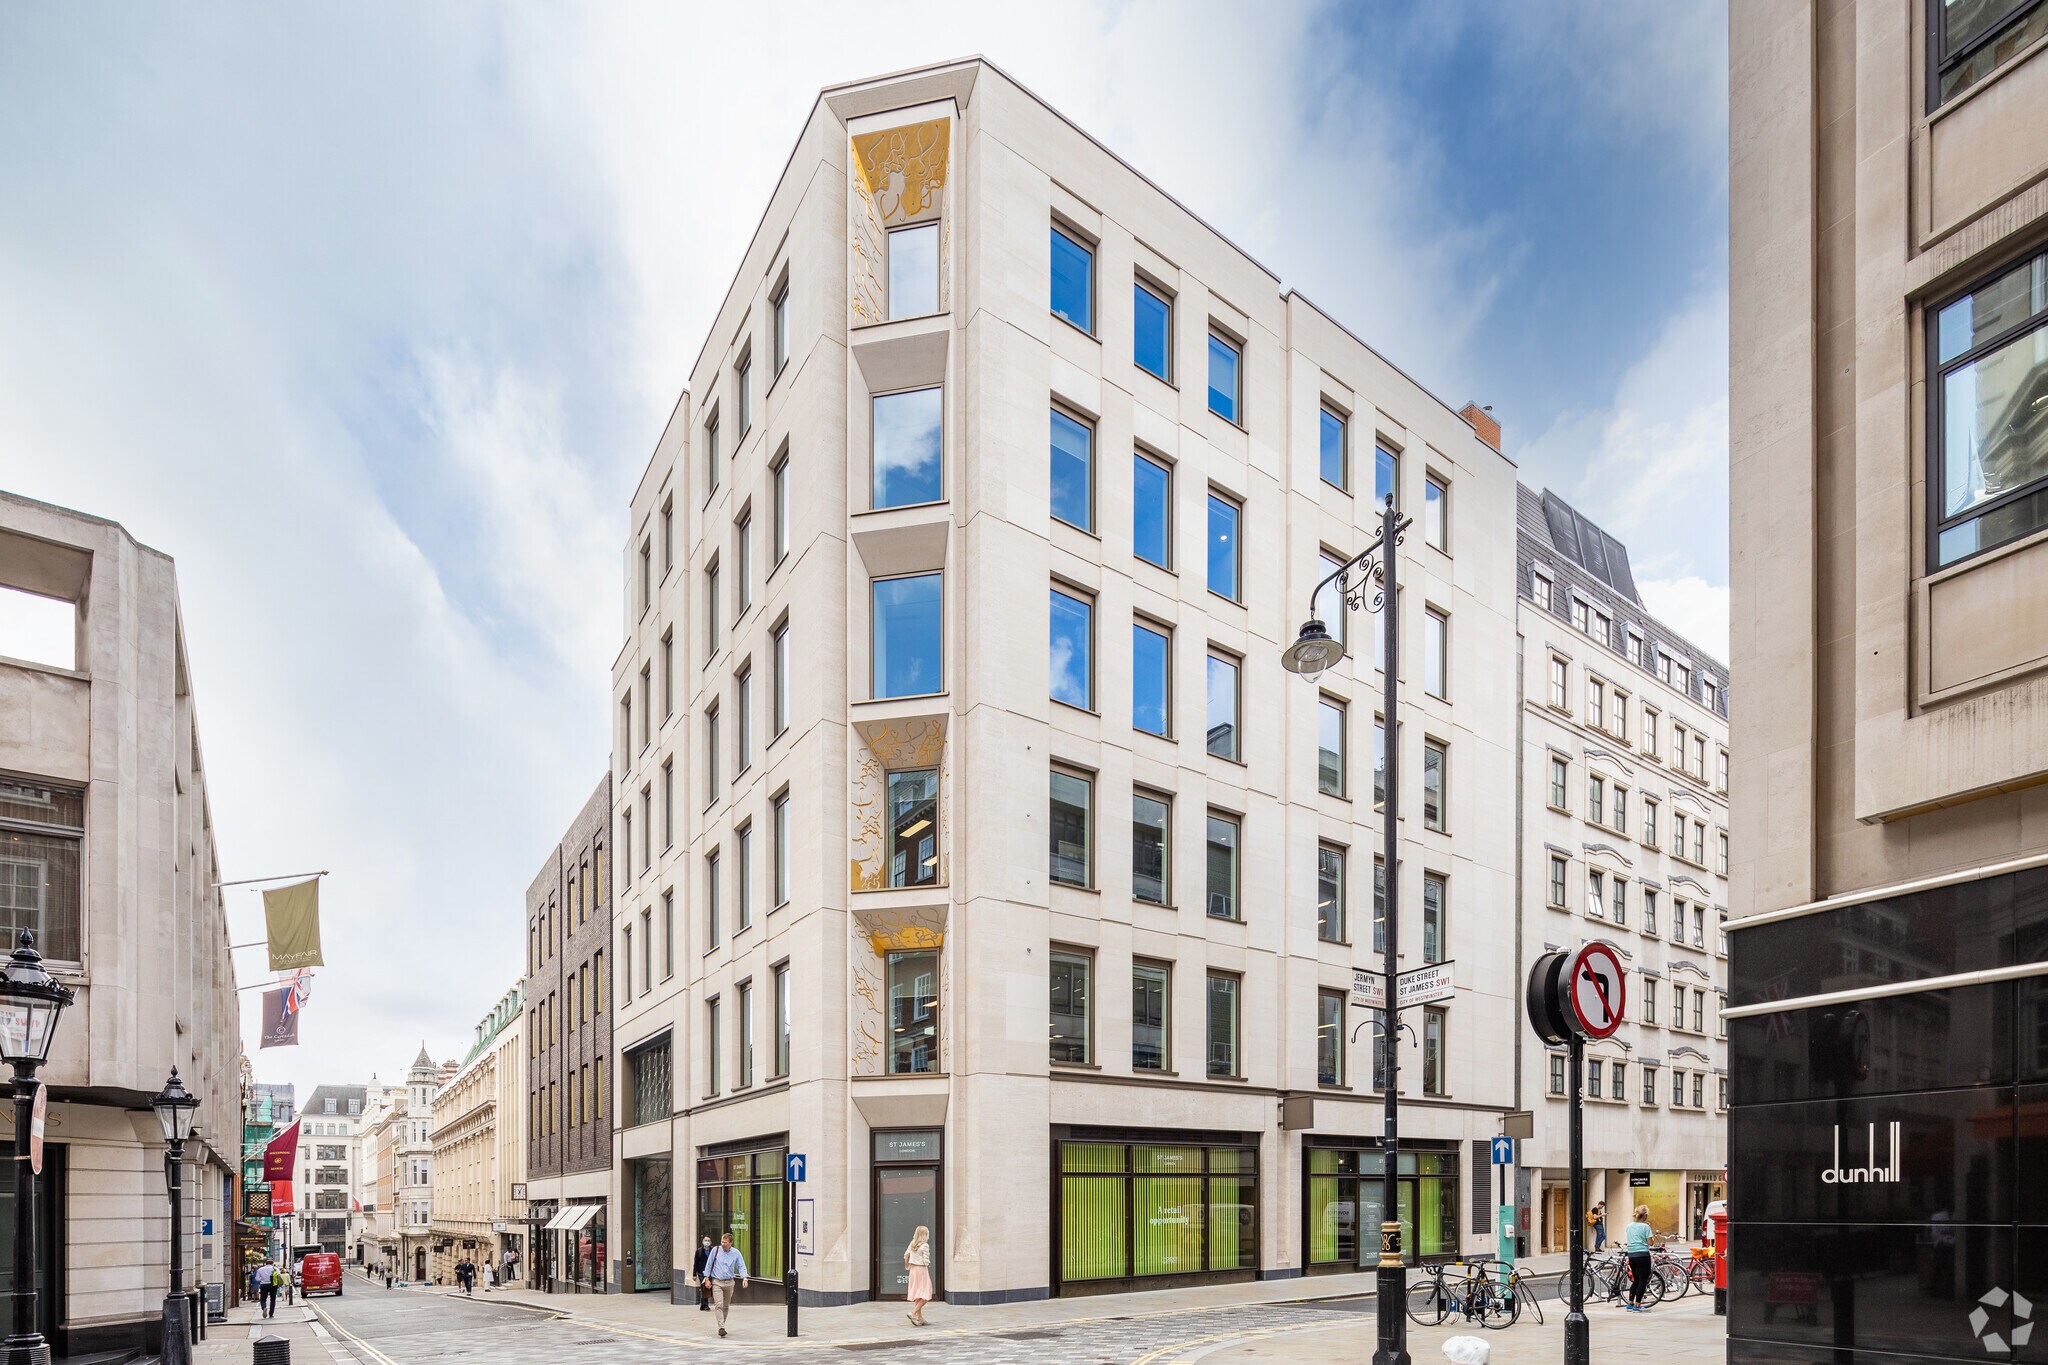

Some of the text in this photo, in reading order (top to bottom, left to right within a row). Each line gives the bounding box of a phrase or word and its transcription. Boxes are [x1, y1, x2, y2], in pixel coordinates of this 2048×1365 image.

[272, 950, 318, 960] MAYFAIR
[1354, 973, 1375, 984] JERMYN
[1400, 969, 1439, 986] DUKE STREET
[1354, 983, 1383, 996] STREET SW1
[1400, 977, 1450, 995] ST JAMES'S SW1
[1414, 991, 1443, 1002] WESTMINSTER
[1821, 1121, 1900, 1183] dunhill
[1164, 1206, 1182, 1214] retail
[1150, 1217, 1190, 1226] opportunity
